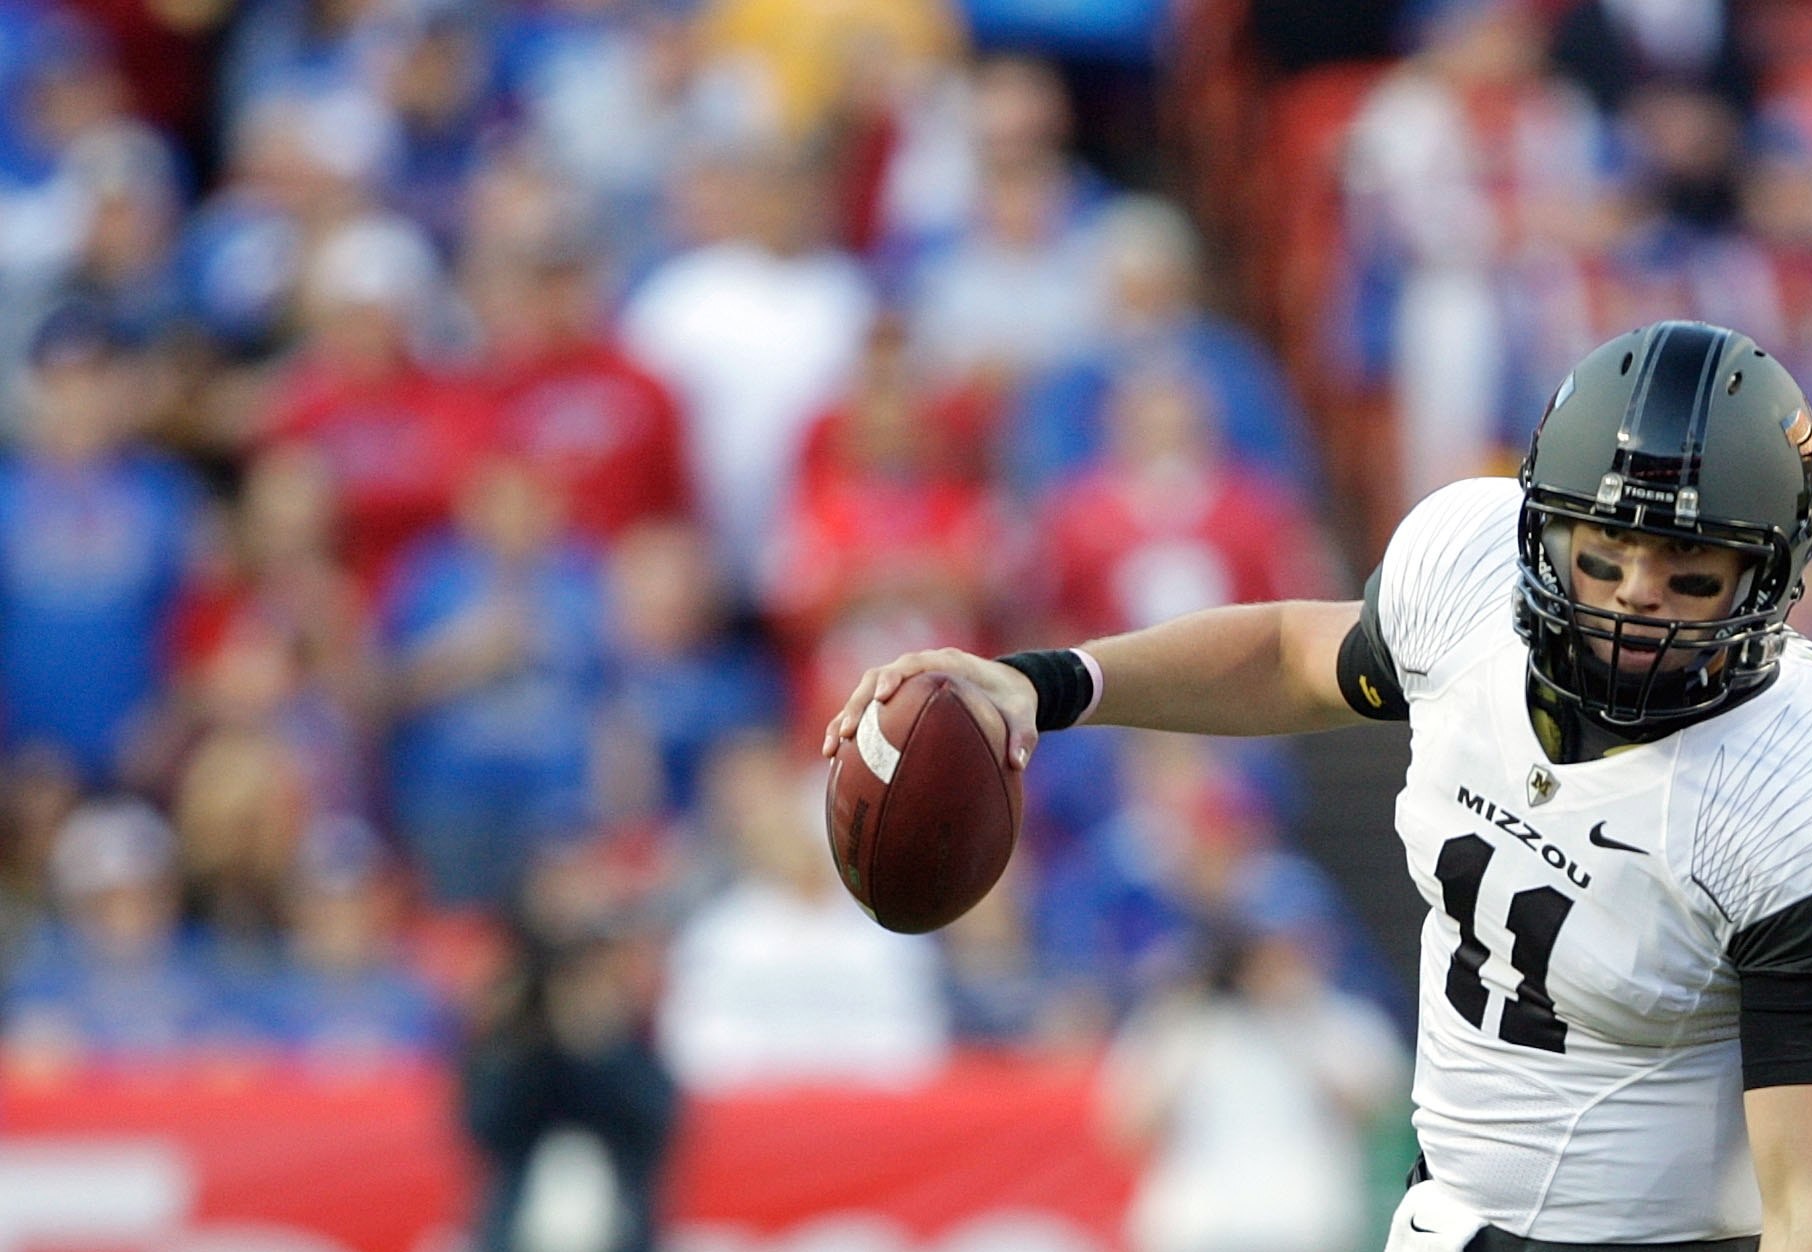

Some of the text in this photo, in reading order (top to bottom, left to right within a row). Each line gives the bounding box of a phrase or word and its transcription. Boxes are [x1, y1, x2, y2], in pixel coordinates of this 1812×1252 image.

[1624, 485, 1675, 503] TIGERS
[1530, 770, 1553, 798] M
[1456, 785, 1593, 889] MIZZOU
[1434, 832, 1576, 1055] 11
